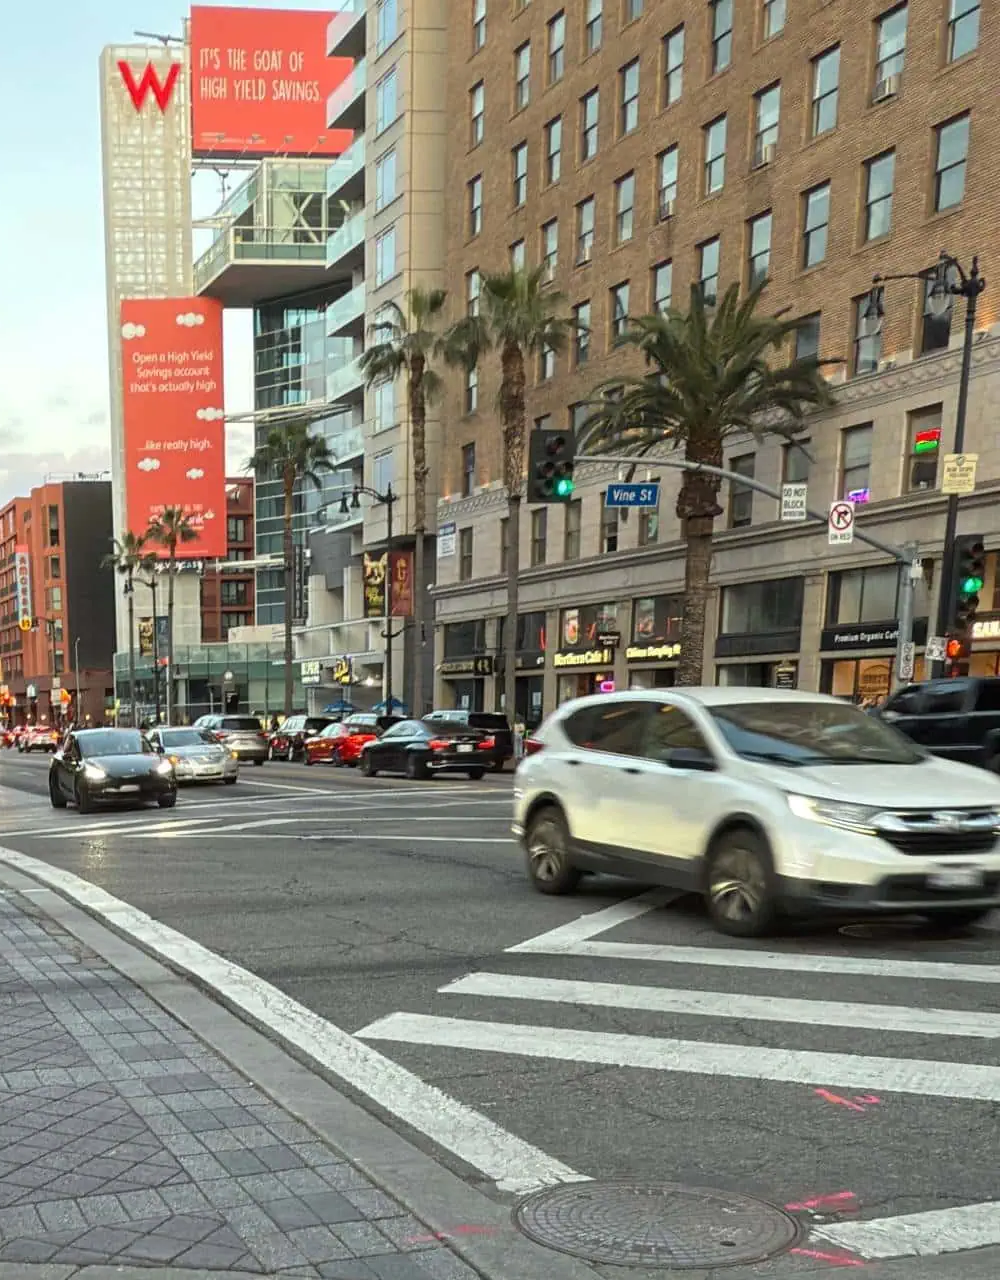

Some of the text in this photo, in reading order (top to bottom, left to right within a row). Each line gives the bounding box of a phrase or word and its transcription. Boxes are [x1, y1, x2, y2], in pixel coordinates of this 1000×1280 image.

[200, 48, 305, 73] IT'S THE GOAT OF
[117, 59, 181, 115] W
[200, 76, 227, 99] HIGH
[233, 78, 267, 101] YIELD
[132, 351, 158, 364] Open
[167, 351, 189, 364] High
[191, 350, 213, 361] Yield
[136, 366, 210, 380] Savings account
[158, 381, 194, 393] actually
[196, 380, 216, 393] high
[613, 489, 653, 502] Vine St
[783, 487, 806, 497] DO NOT
[783, 500, 804, 509] BLOCK
[834, 634, 859, 643] Premium
[860, 632, 884, 643] Organic
